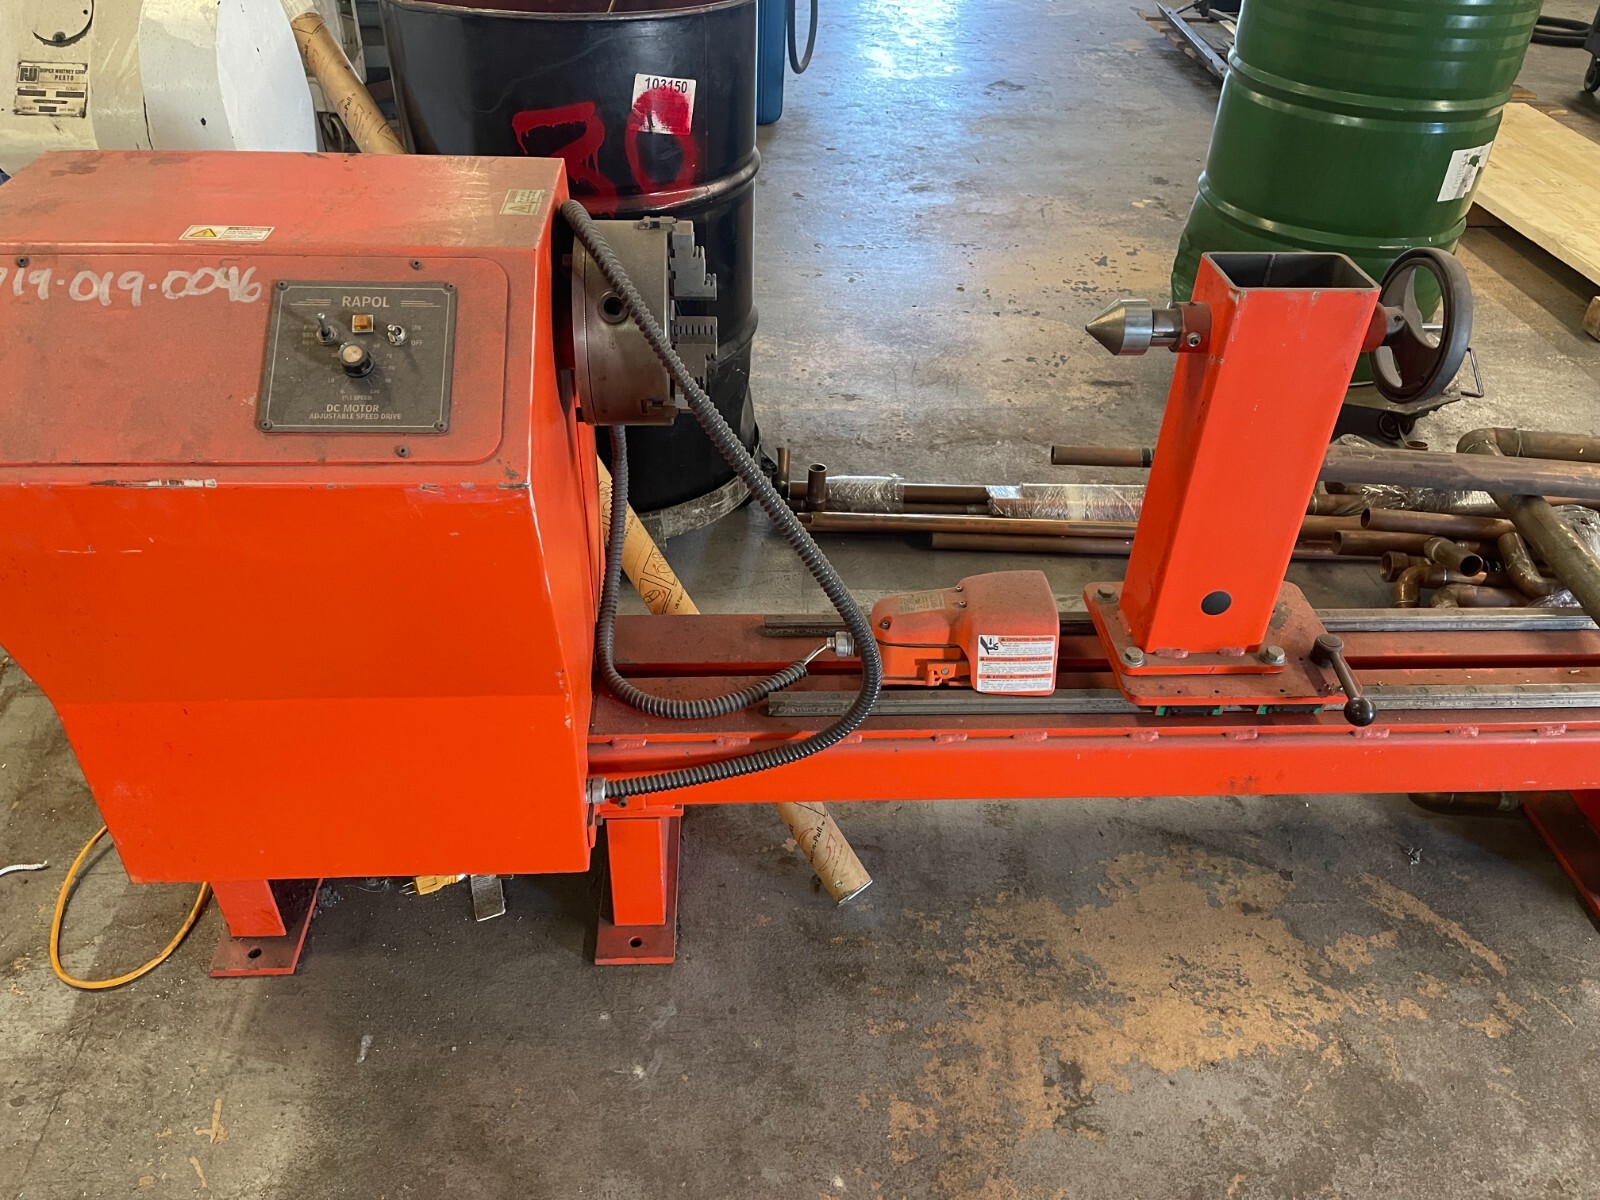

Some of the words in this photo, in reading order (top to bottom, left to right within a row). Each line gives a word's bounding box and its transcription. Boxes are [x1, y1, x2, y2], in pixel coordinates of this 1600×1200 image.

[645, 77, 688, 94] 103150
[342, 295, 390, 308] RAPOL
[326, 404, 340, 412] DC
[343, 404, 379, 413] MOTOR
